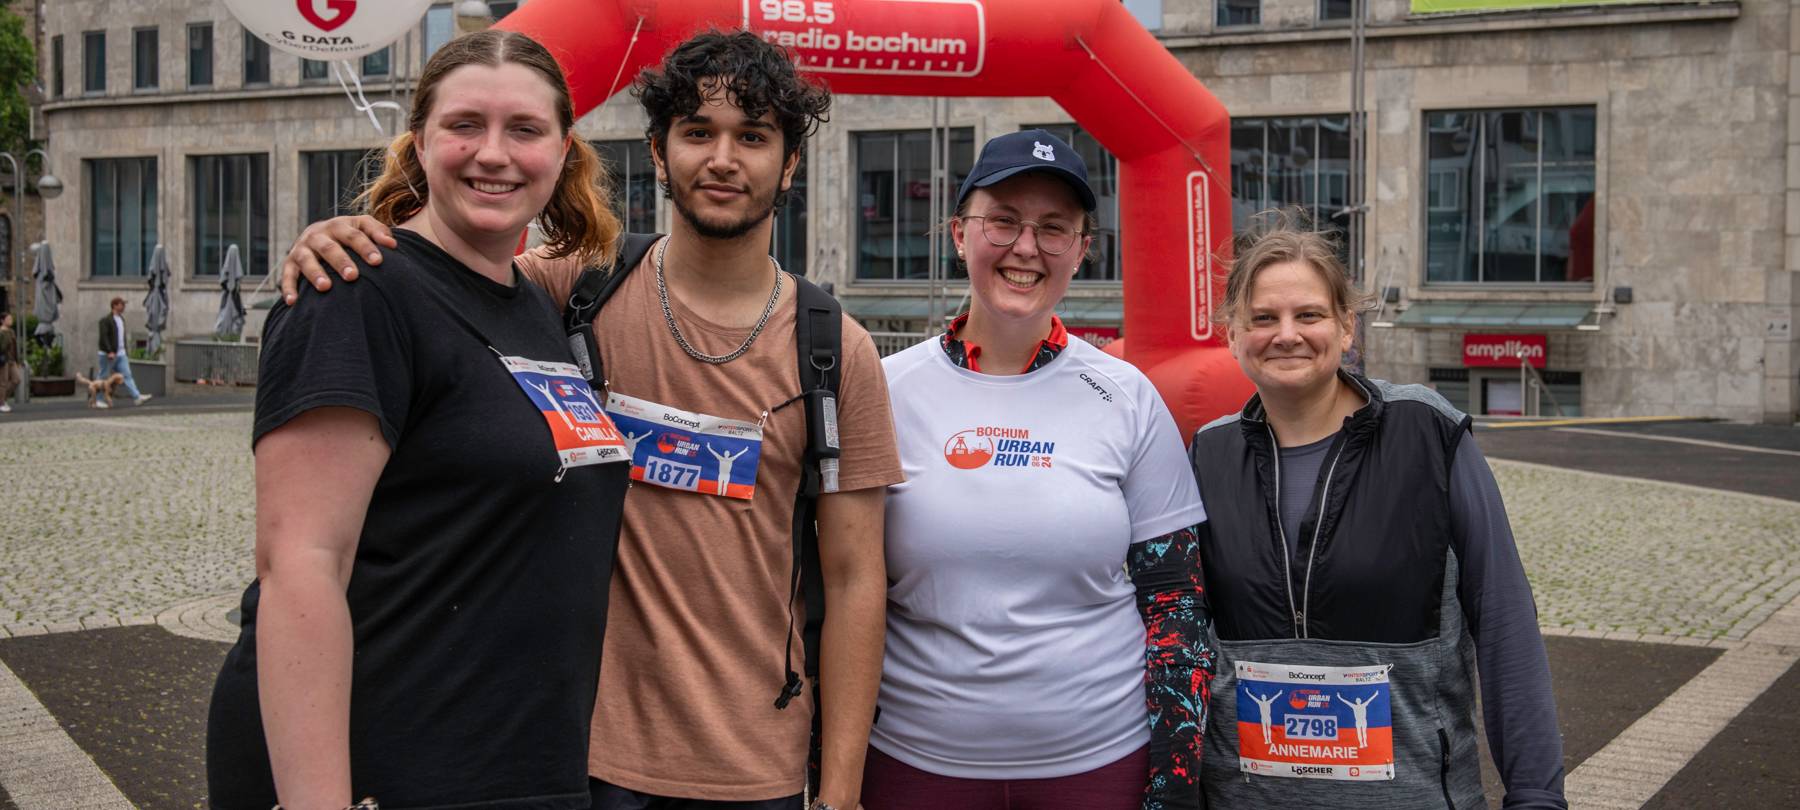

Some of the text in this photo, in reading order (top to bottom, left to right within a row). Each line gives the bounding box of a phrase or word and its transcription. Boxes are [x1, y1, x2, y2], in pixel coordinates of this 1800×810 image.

[760, 0, 835, 24] 98.5
[281, 30, 353, 45] G DATA
[763, 28, 967, 54] radio bochum
[1465, 340, 1543, 360] amplifon
[1080, 373, 1107, 395] CRAFT
[663, 413, 700, 429] BoConcept
[575, 427, 621, 441] CAMILLA
[976, 427, 1029, 439] BOCHUM
[997, 439, 1055, 454] URBAN
[994, 453, 1030, 467] RUN
[1041, 456, 1052, 468] 24
[648, 460, 700, 488] 1877
[1288, 671, 1326, 681] BoConcept
[1286, 717, 1337, 737] 2798
[1268, 743, 1358, 759] ANNEMARIE
[1291, 765, 1333, 775] LÖSCHER
